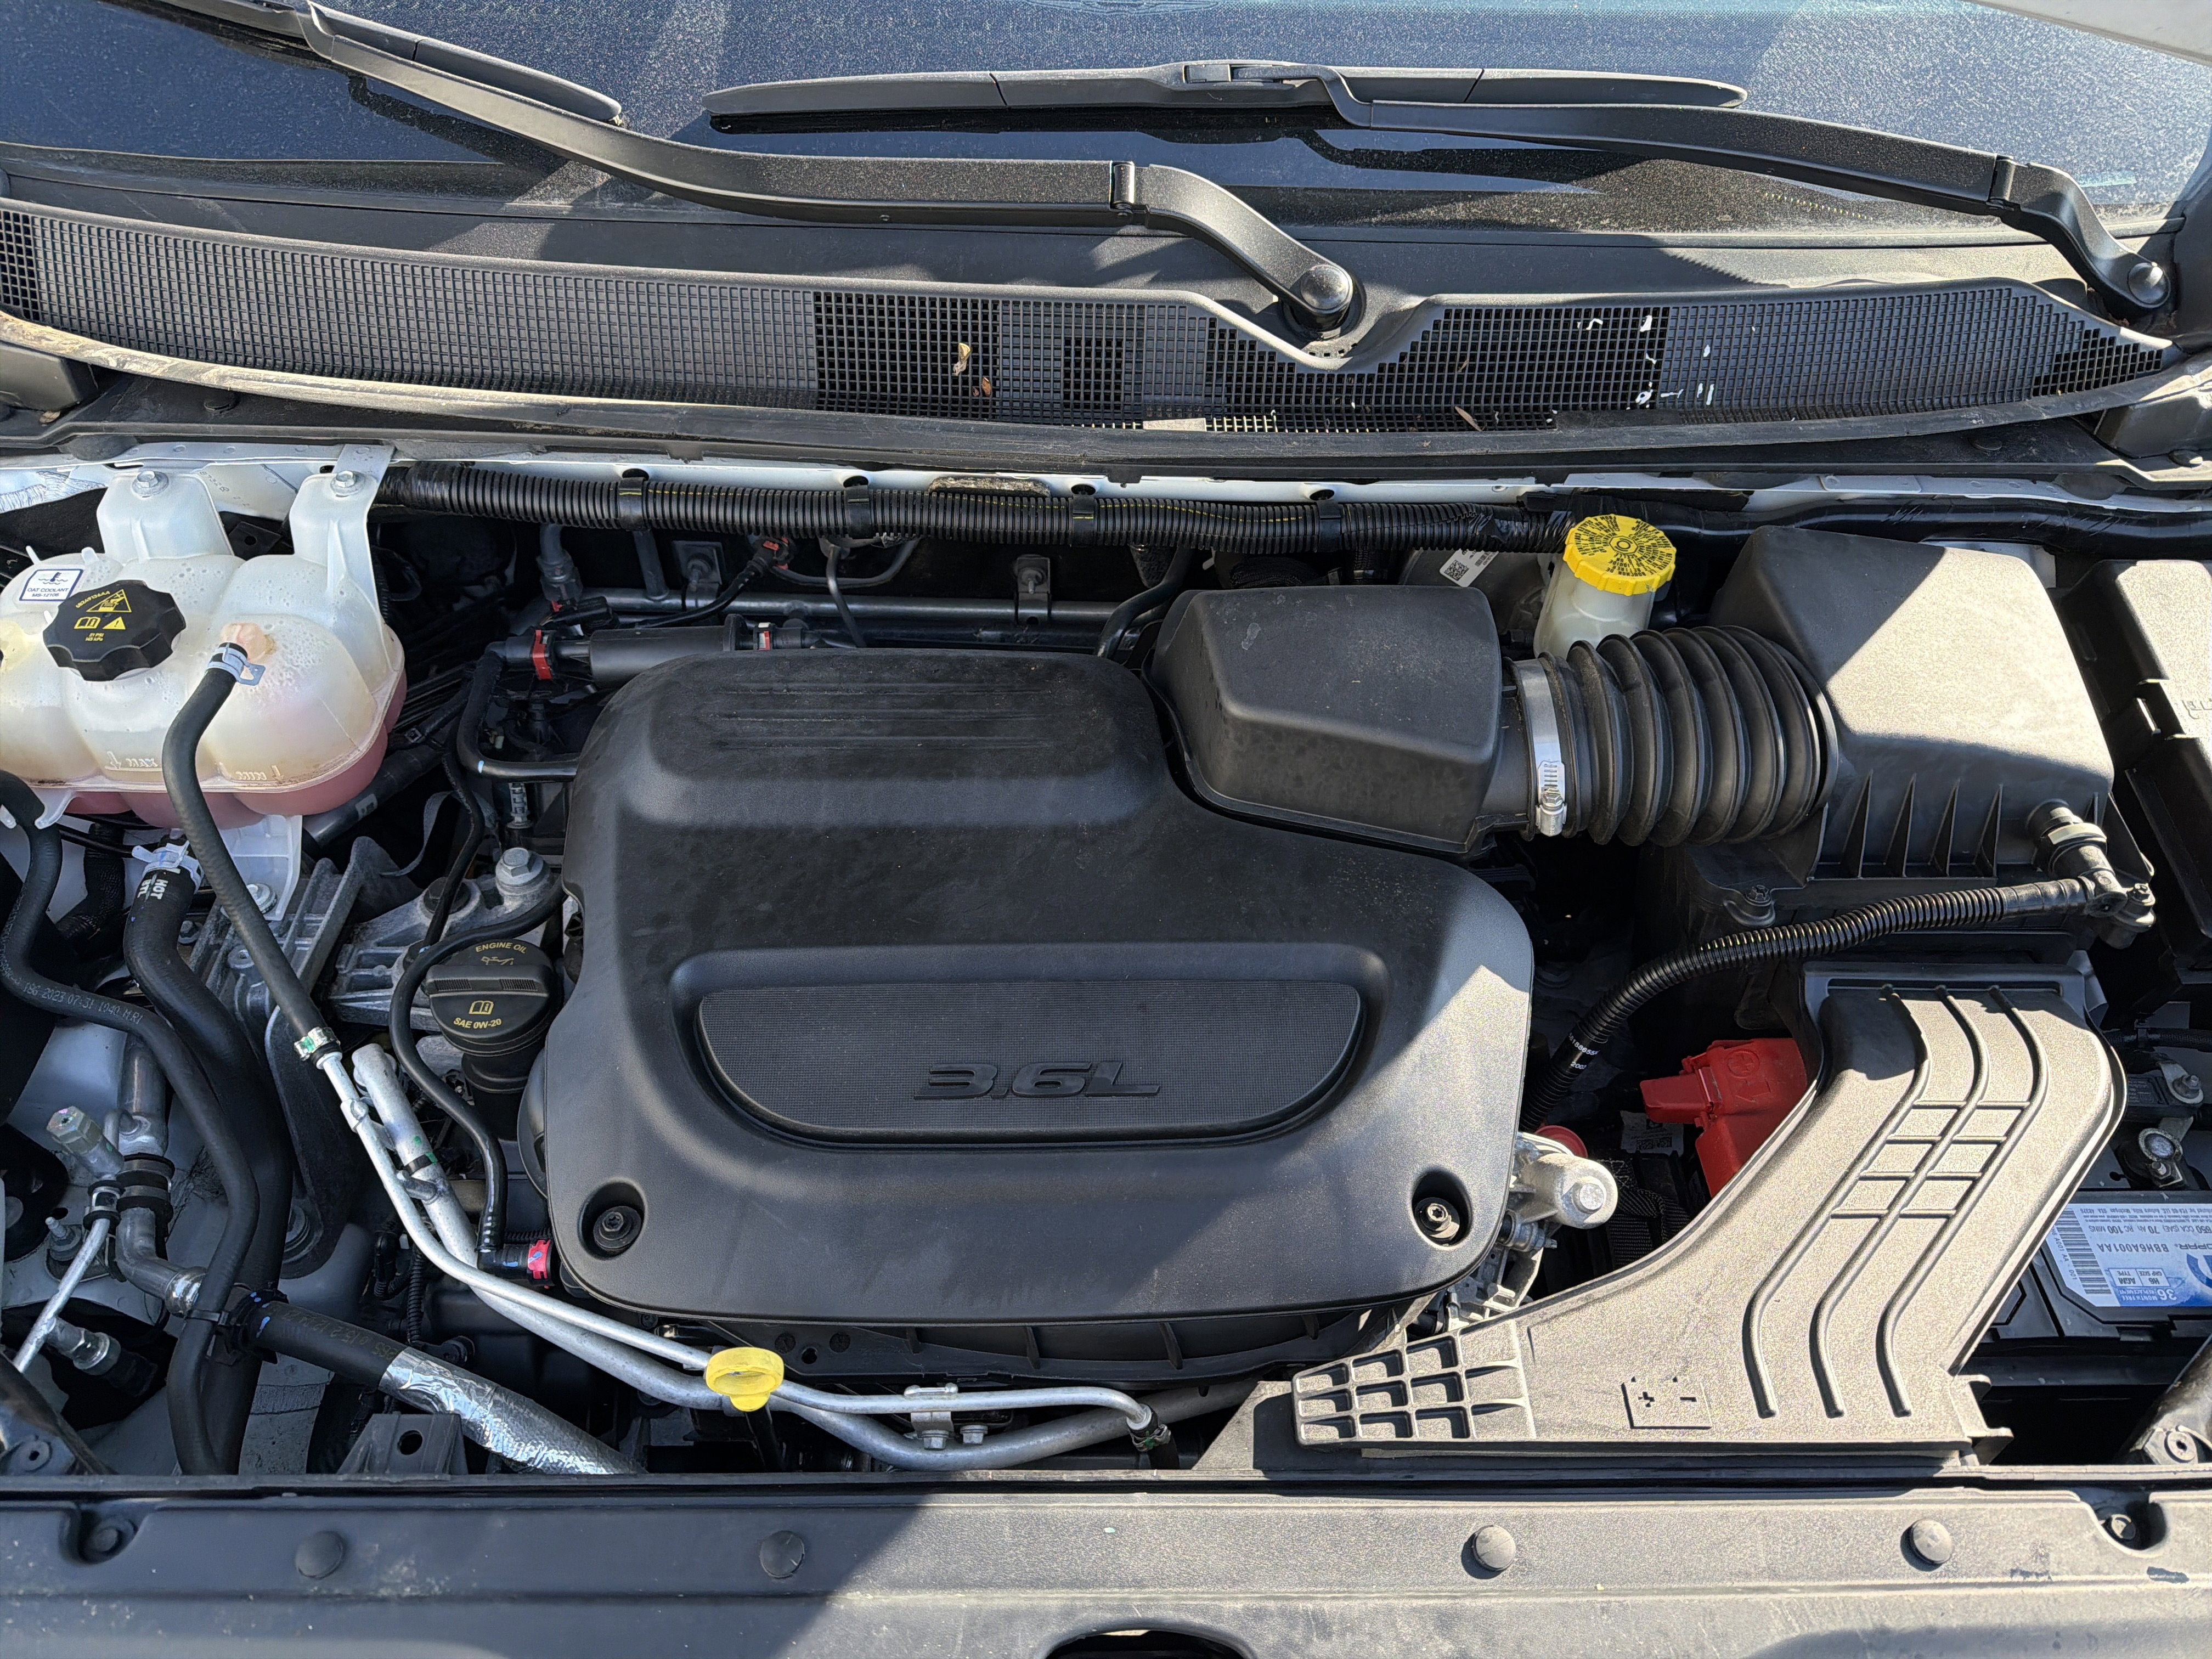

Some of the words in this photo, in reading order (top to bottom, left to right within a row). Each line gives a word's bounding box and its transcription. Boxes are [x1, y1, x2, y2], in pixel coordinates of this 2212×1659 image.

[1577, 520, 1594, 532] SEALED
[1574, 532, 1587, 555] CONTAINER
[1656, 552, 1672, 571] NETTOYER
[150, 879, 168, 900] HOT
[476, 942, 513, 952] ENGINE
[513, 944, 528, 954] OIL
[42, 988, 66, 1002] 2023
[453, 1017, 473, 1029] SAE
[473, 1018, 503, 1029] 0W-20
[913, 1060, 1163, 1100] 3.6L
[2107, 1226, 2124, 1234] 100
[2148, 1226, 2160, 1234] 70
[2162, 1224, 2180, 1233] (SAE)
[2195, 1225, 2212, 1234] 650
[2096, 1243, 2169, 1252] BBH6A001AA
[2054, 1237, 2065, 1251] A001
[2068, 1269, 2078, 1280] 001
[2157, 1289, 2177, 1301] 36
